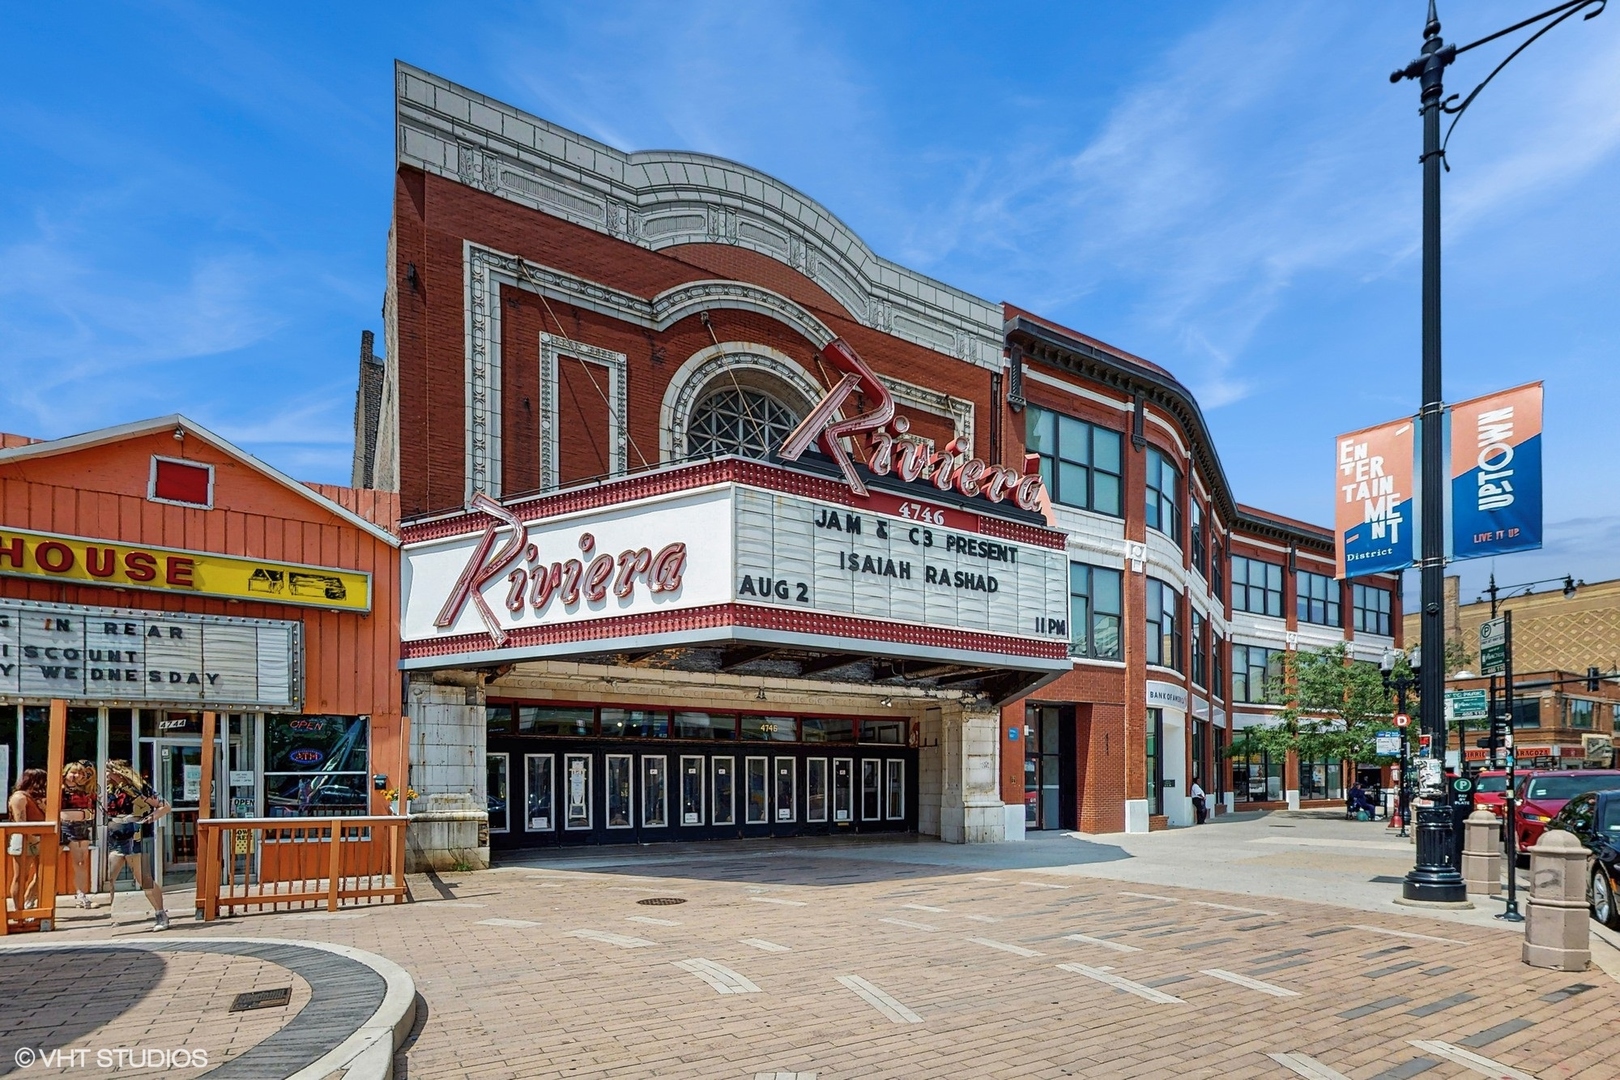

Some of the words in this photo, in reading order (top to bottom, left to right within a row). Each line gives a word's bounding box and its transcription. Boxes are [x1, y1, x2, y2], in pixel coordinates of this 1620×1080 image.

[779, 336, 1046, 512] Riviera
[1478, 406, 1514, 511] UPTOWN
[899, 501, 945, 526] 4746
[815, 509, 862, 535] JAM
[876, 520, 888, 540] &
[908, 527, 933, 548] C3
[946, 534, 1018, 564] PRESENT
[1473, 532, 1493, 544] LIVE
[1496, 530, 1505, 540] IT
[1508, 528, 1520, 538] UP
[0, 536, 195, 588] HOUSE
[1347, 548, 1393, 562] District
[433, 491, 687, 648] Riviera
[840, 551, 911, 580] ISAIAH
[925, 565, 999, 593] RASHAD
[739, 575, 789, 600] AUG
[796, 583, 809, 603] 2
[44, 618, 70, 632] IN
[104, 621, 183, 640] REAR
[2, 643, 137, 663] ISCOUNT
[39, 665, 220, 685] WEDNESDAY
[1150, 691, 1166, 700] BANK
[159, 719, 186, 730] 4744
[290, 720, 324, 731] OPEN
[760, 724, 778, 733] 4746
[296, 752, 318, 761] ATM
[234, 798, 255, 807] OPEN
